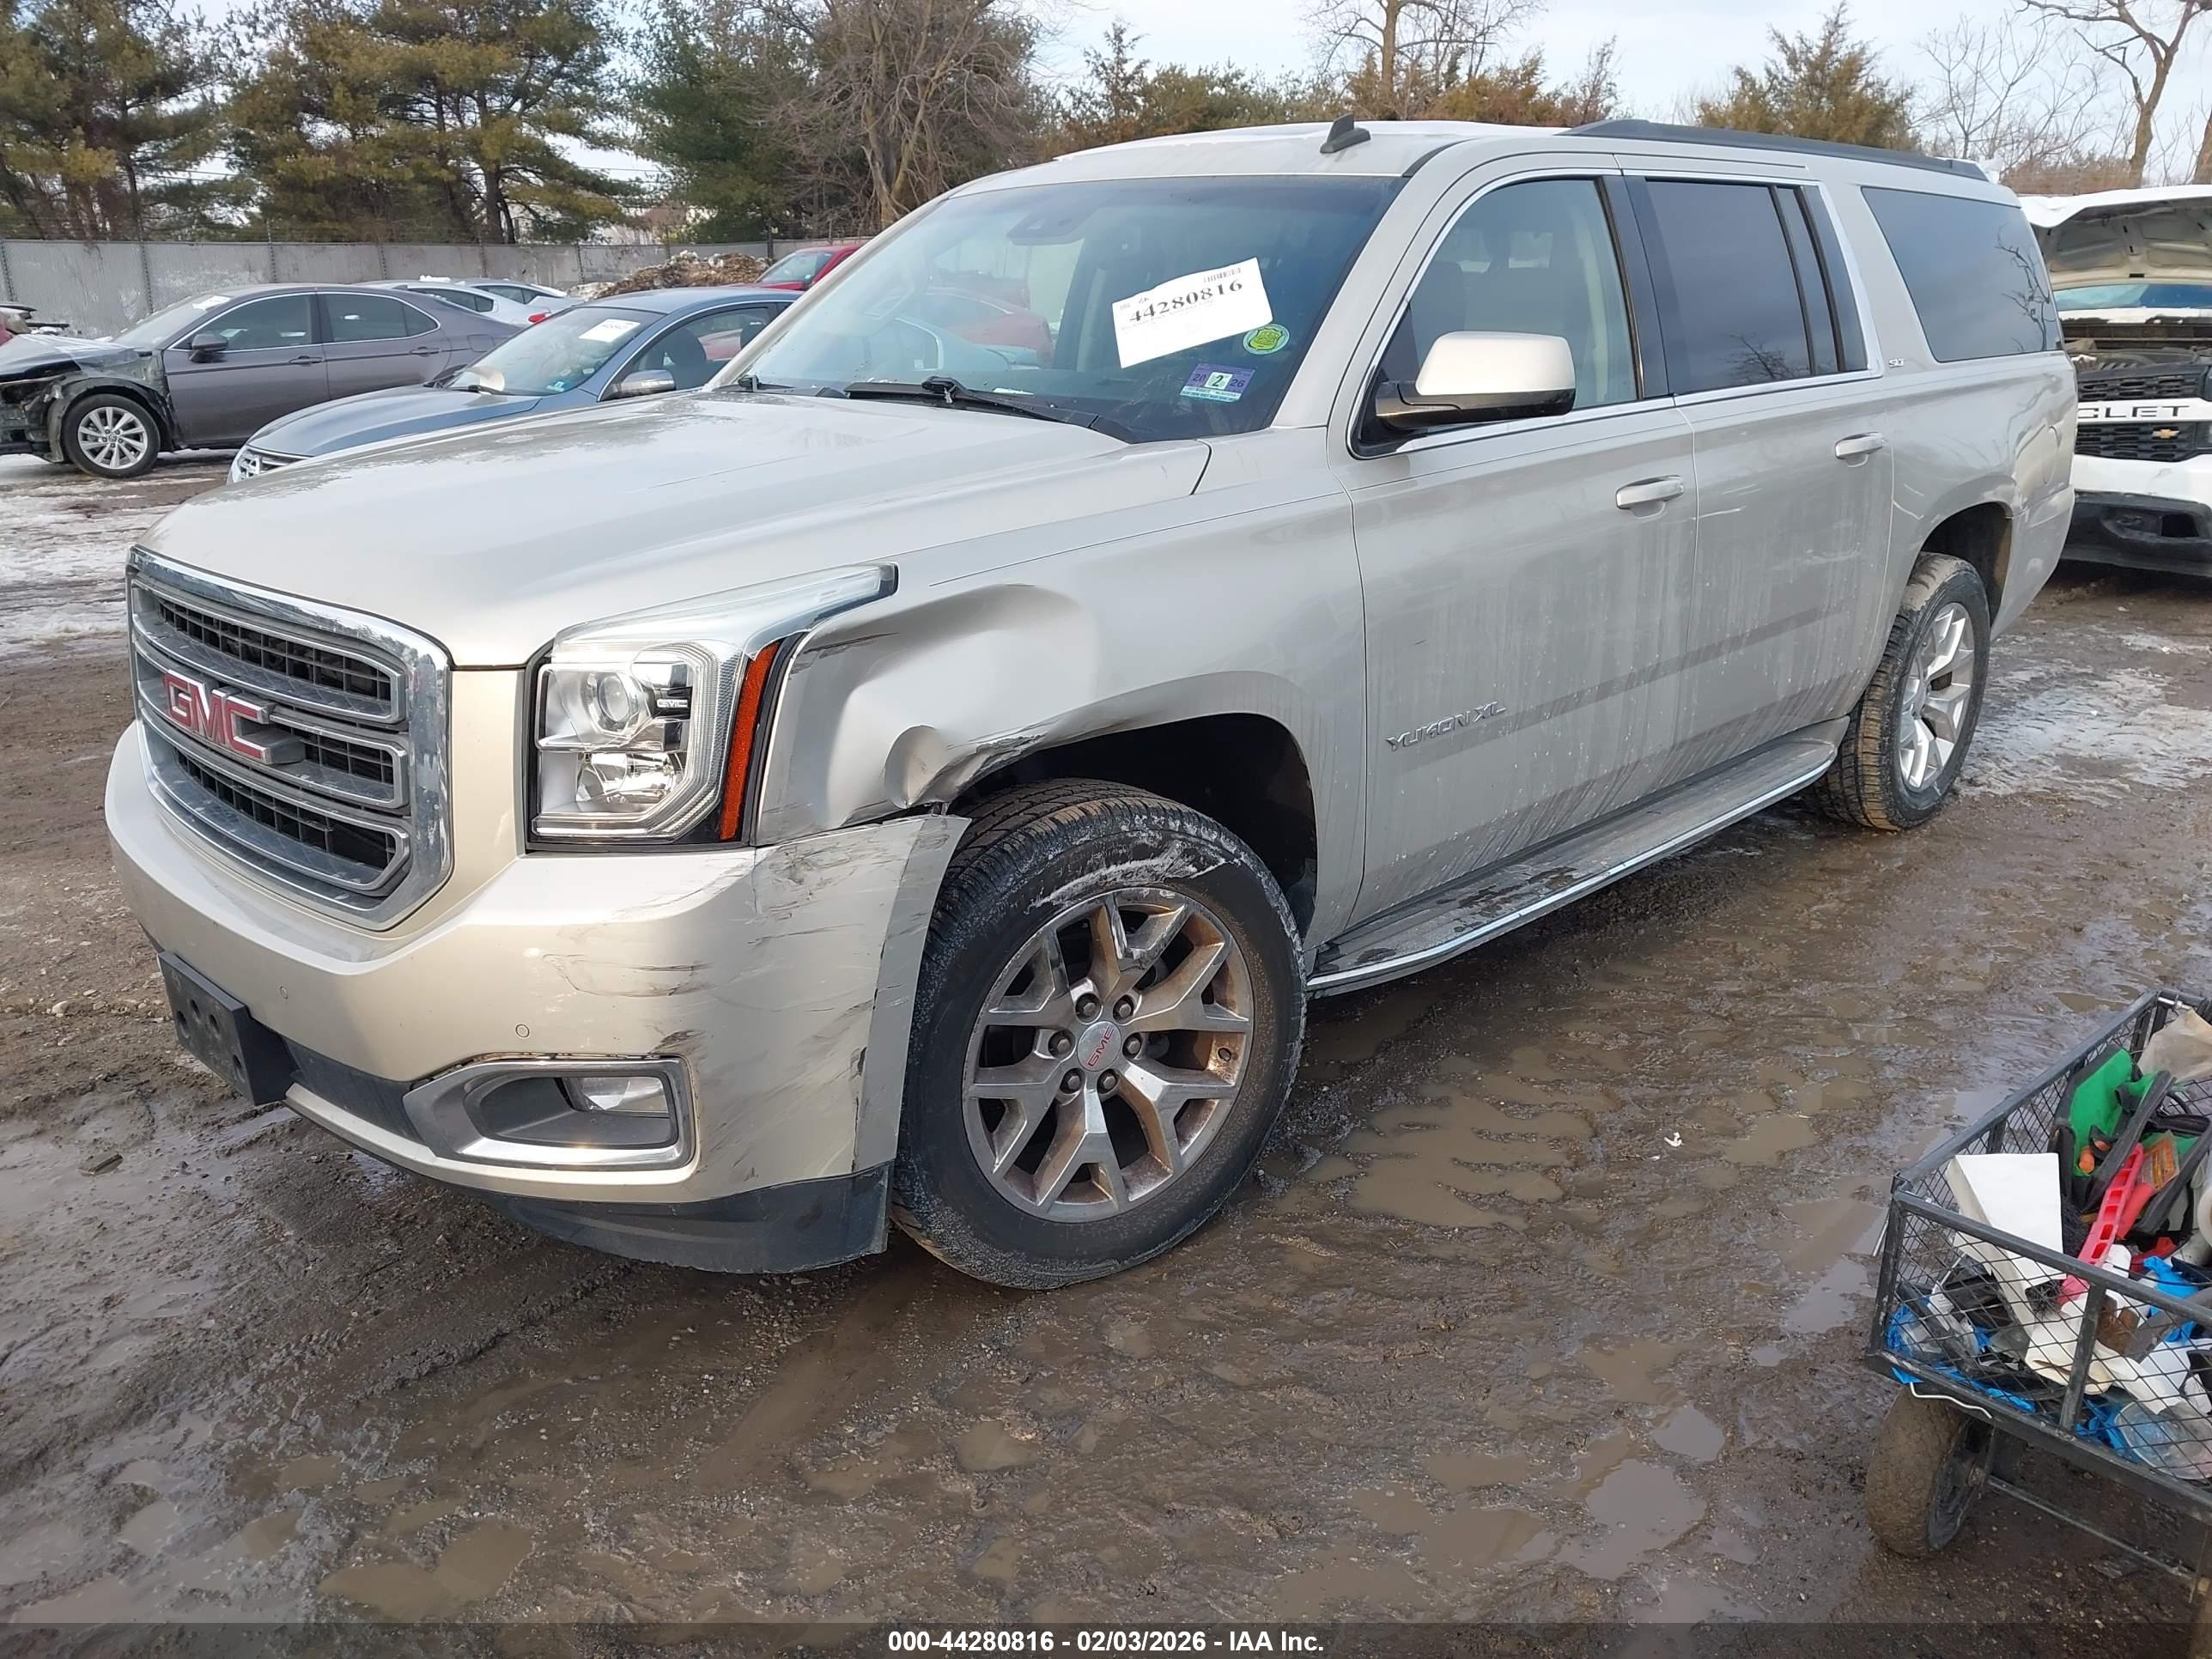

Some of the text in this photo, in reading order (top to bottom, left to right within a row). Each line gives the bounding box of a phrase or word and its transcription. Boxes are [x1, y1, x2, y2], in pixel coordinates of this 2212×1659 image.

[1130, 279, 1243, 322] 44280816
[1192, 373, 1245, 388] 20 2 26
[164, 669, 270, 766] GMC
[1385, 701, 1508, 751] YUKON XL
[1086, 1025, 1115, 1068] GMC
